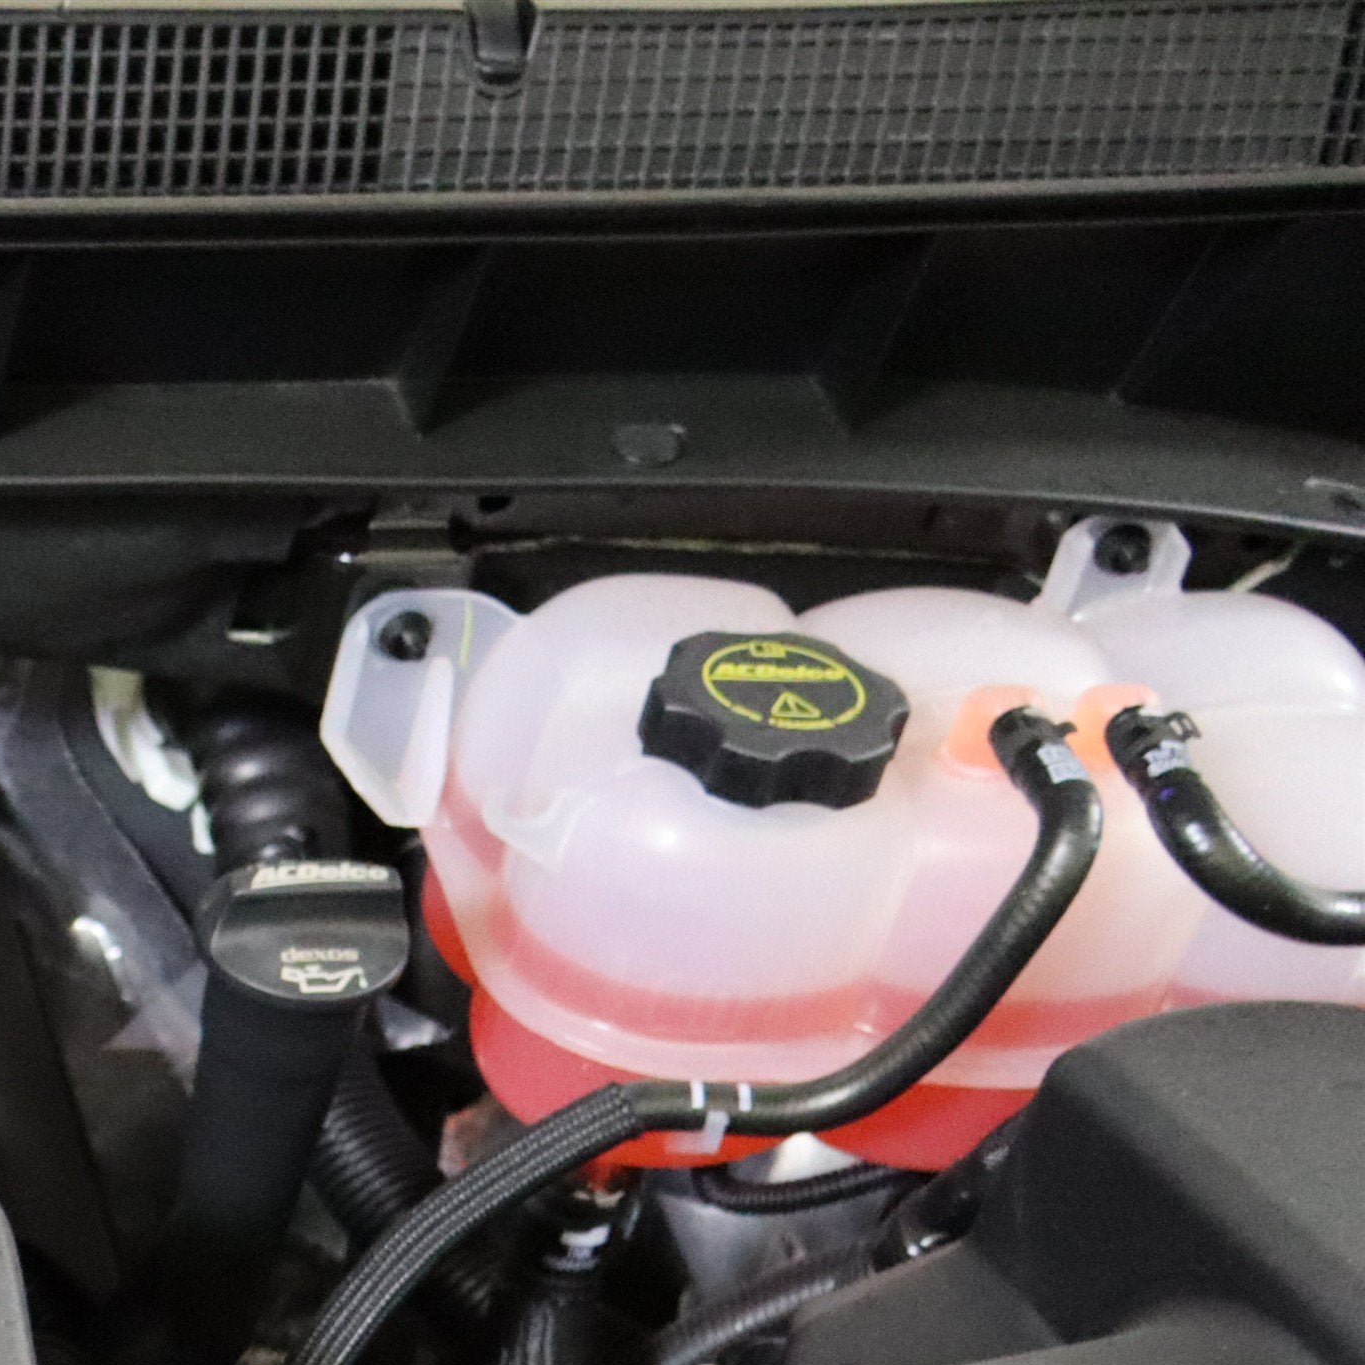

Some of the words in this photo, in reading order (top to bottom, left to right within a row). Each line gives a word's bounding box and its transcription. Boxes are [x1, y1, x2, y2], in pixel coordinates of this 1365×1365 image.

[711, 662, 847, 681] ACDelco
[250, 862, 389, 890] ACDelco
[280, 948, 359, 963] dexos
